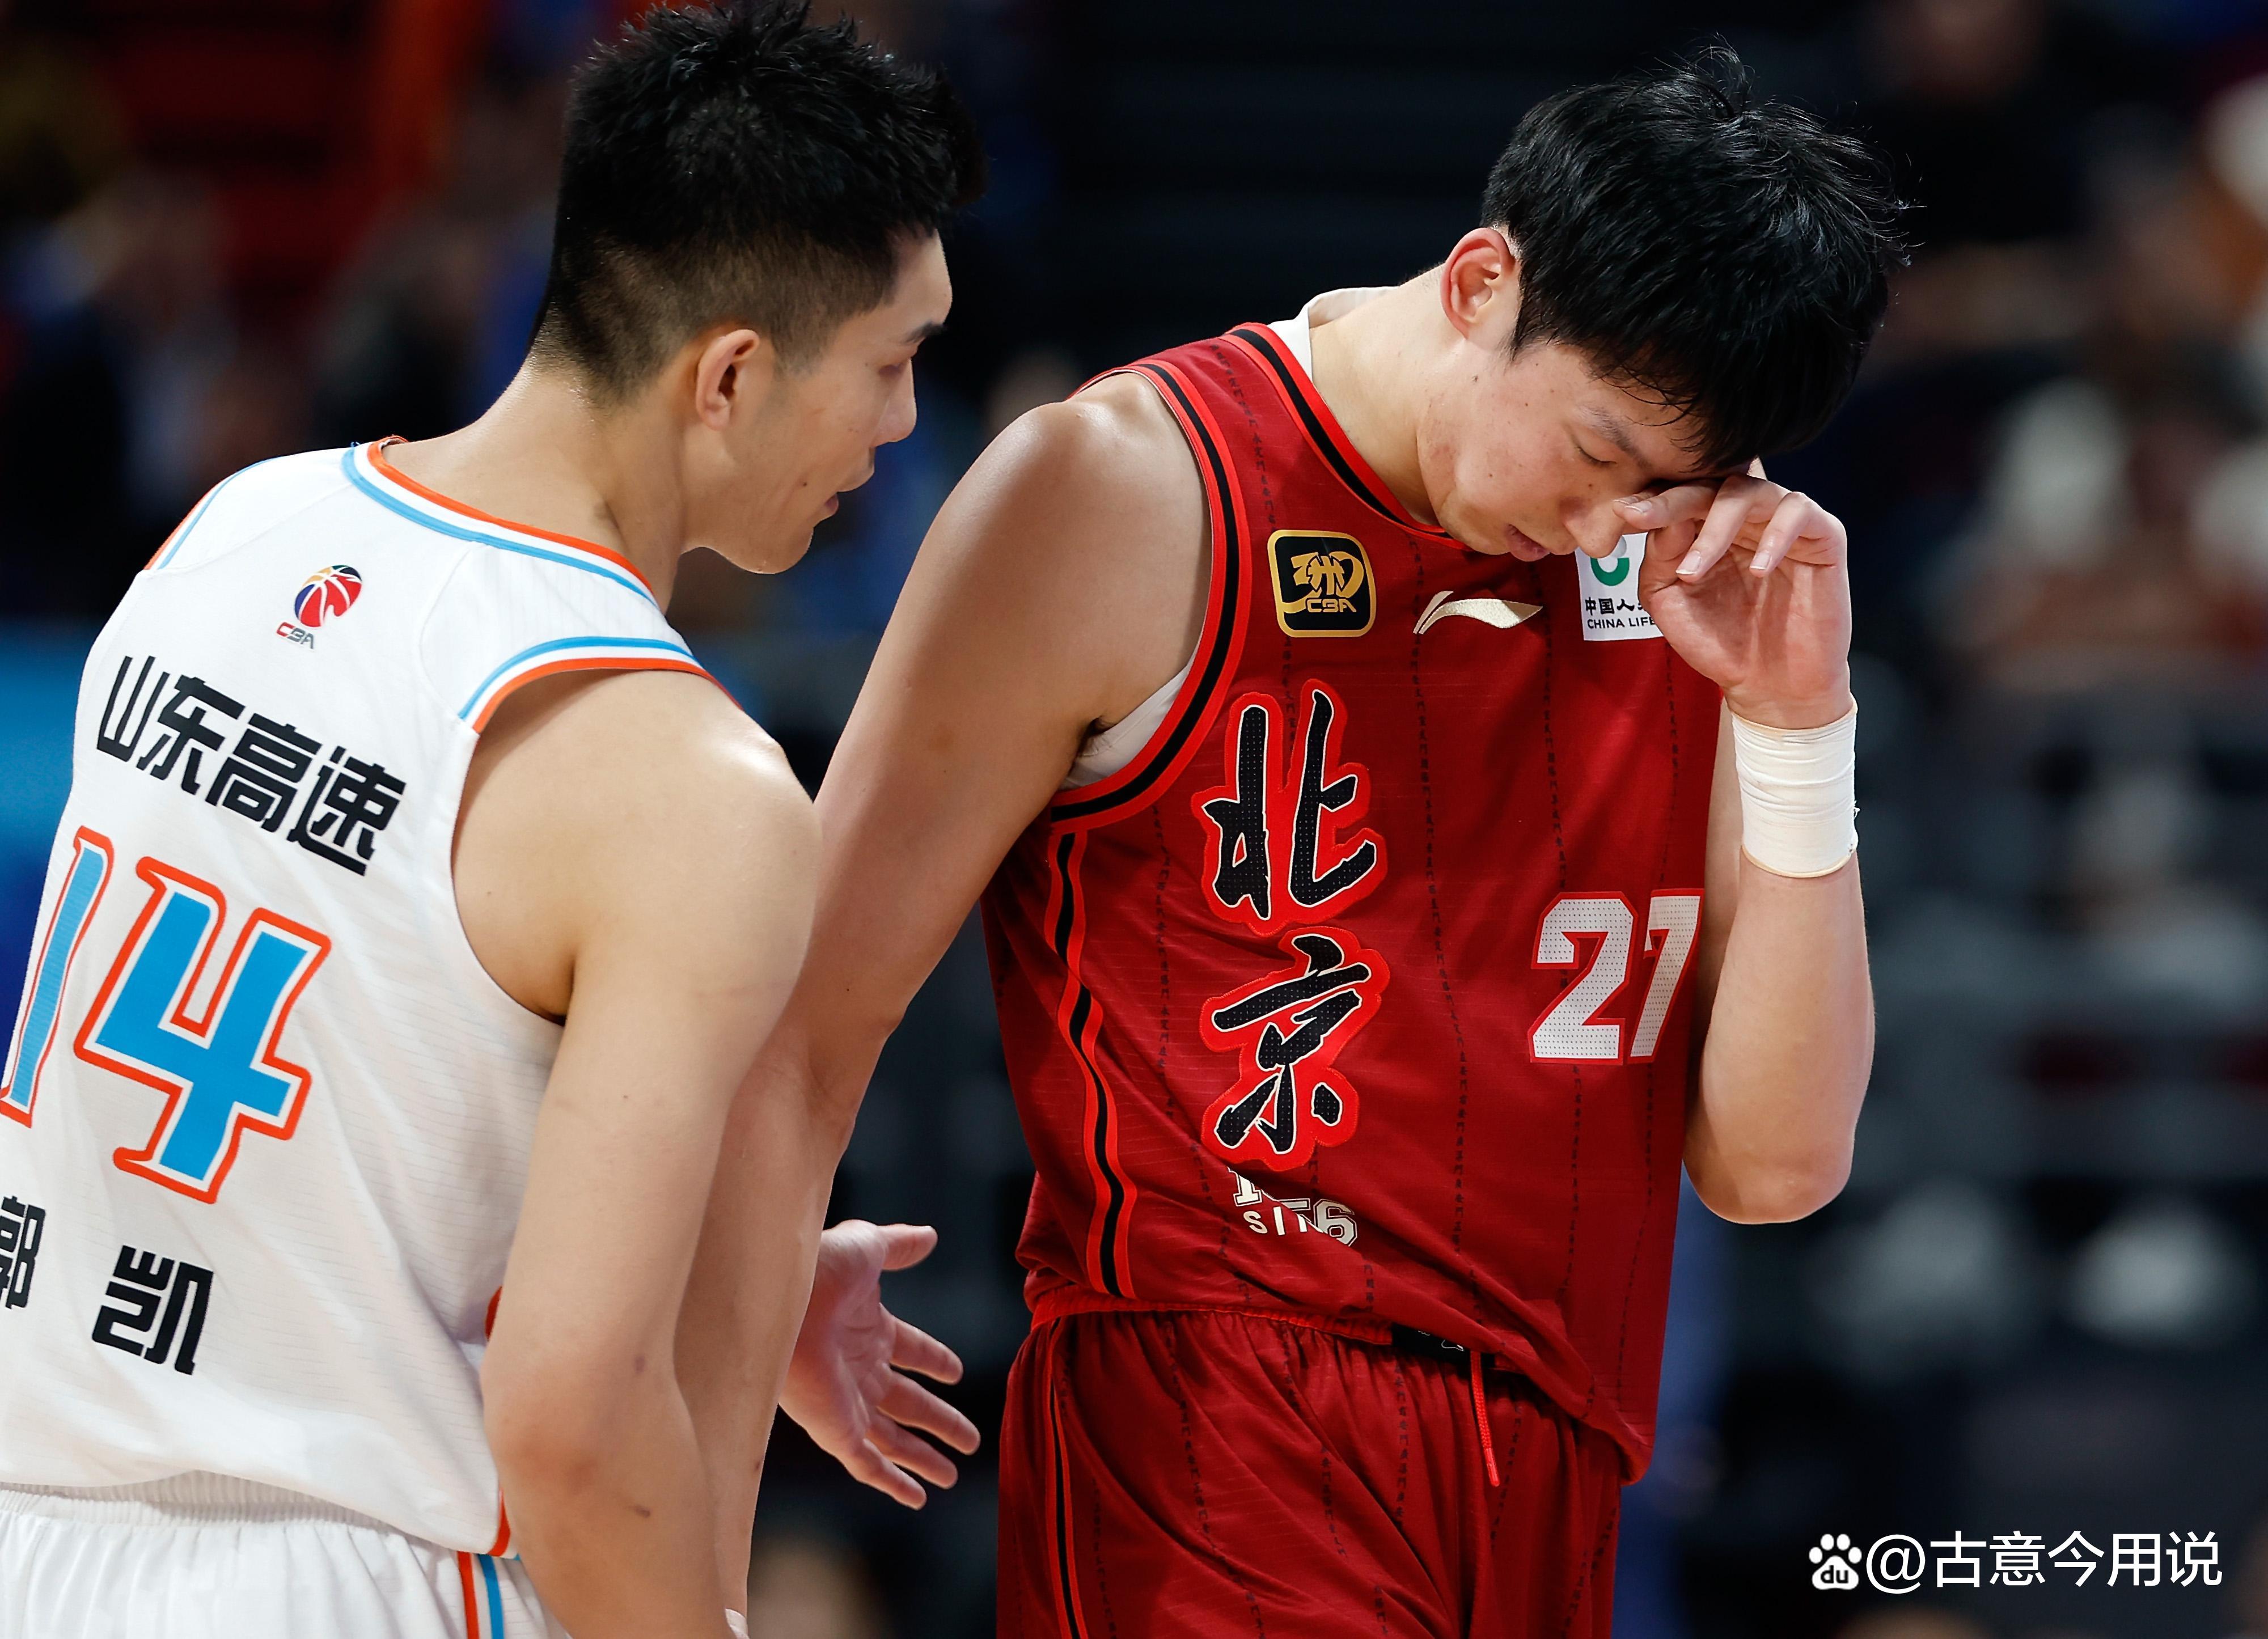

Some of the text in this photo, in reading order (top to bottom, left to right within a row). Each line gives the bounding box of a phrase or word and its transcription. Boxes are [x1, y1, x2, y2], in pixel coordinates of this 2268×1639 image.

[277, 622, 314, 649] CBA
[1307, 599, 1357, 613] CBA
[1585, 597, 1643, 616] 中国人
[1587, 619, 1625, 629] CHINA
[97, 655, 407, 876] 山东高速
[1200, 688, 1377, 1155] 北京
[0, 825, 332, 1204] 14
[1532, 894, 1702, 1060] 27
